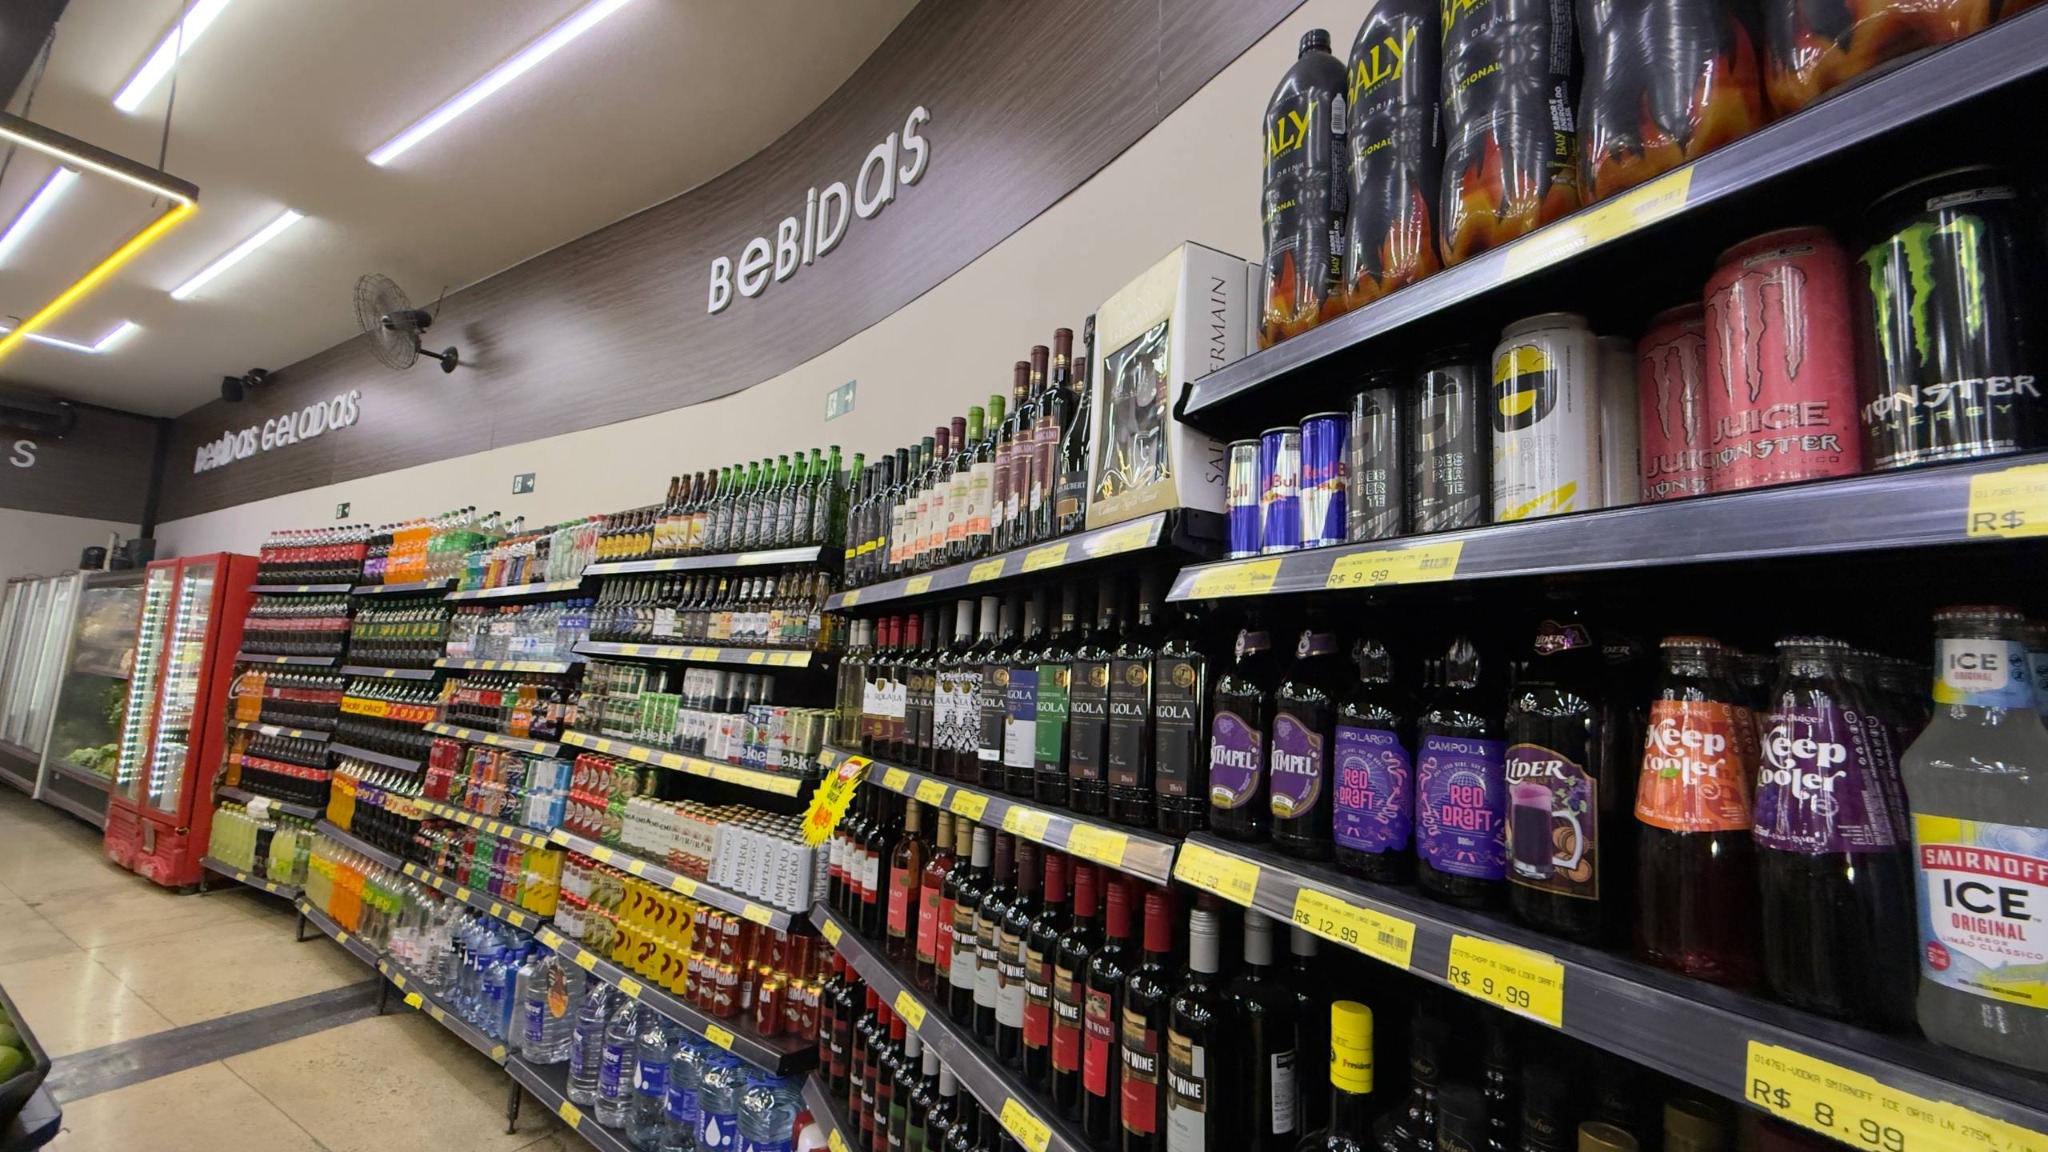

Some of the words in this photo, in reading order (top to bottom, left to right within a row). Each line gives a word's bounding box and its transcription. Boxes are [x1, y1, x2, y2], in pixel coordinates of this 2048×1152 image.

[1263, 101, 1319, 167] ALY
[1209, 276, 1226, 374] ERMAIN
[1713, 401, 1830, 443] JUICE
[1871, 403, 2012, 437] ENERGY
[1648, 448, 1712, 479] JUIC
[1972, 510, 2025, 533] R$
[1329, 574, 1346, 584] R$
[1352, 569, 1389, 583] 9.99
[1950, 652, 1998, 671] ICE
[1427, 740, 1468, 754] CAMPO
[1645, 718, 1726, 758] Keep
[1760, 725, 1847, 769] Keep
[1925, 849, 2048, 882] SMIRNOFF
[1942, 878, 2032, 921] ICE
[961, 932, 978, 945] WINE
[1294, 909, 1311, 925] R$
[1317, 917, 1359, 944] 12.99
[1951, 912, 2027, 942] ORIGINAL
[1969, 934, 2009, 947] SABOR
[982, 946, 998, 961] WINE
[1006, 964, 1025, 978] WINE
[1031, 981, 1048, 998] WINE
[1449, 965, 1471, 986] R$
[1482, 977, 1530, 1008] 9.99
[1059, 1001, 1078, 1019] WINE
[1131, 1051, 1153, 1072] WINE
[1177, 1076, 1201, 1099] WINE
[1753, 1078, 1791, 1109] R$
[1814, 1101, 1905, 1152] 8.99
[1825, 1078, 1875, 1102] SMIRNOFF
[1881, 1097, 1900, 1112] ICE
[1940, 1116, 1956, 1131] LN
